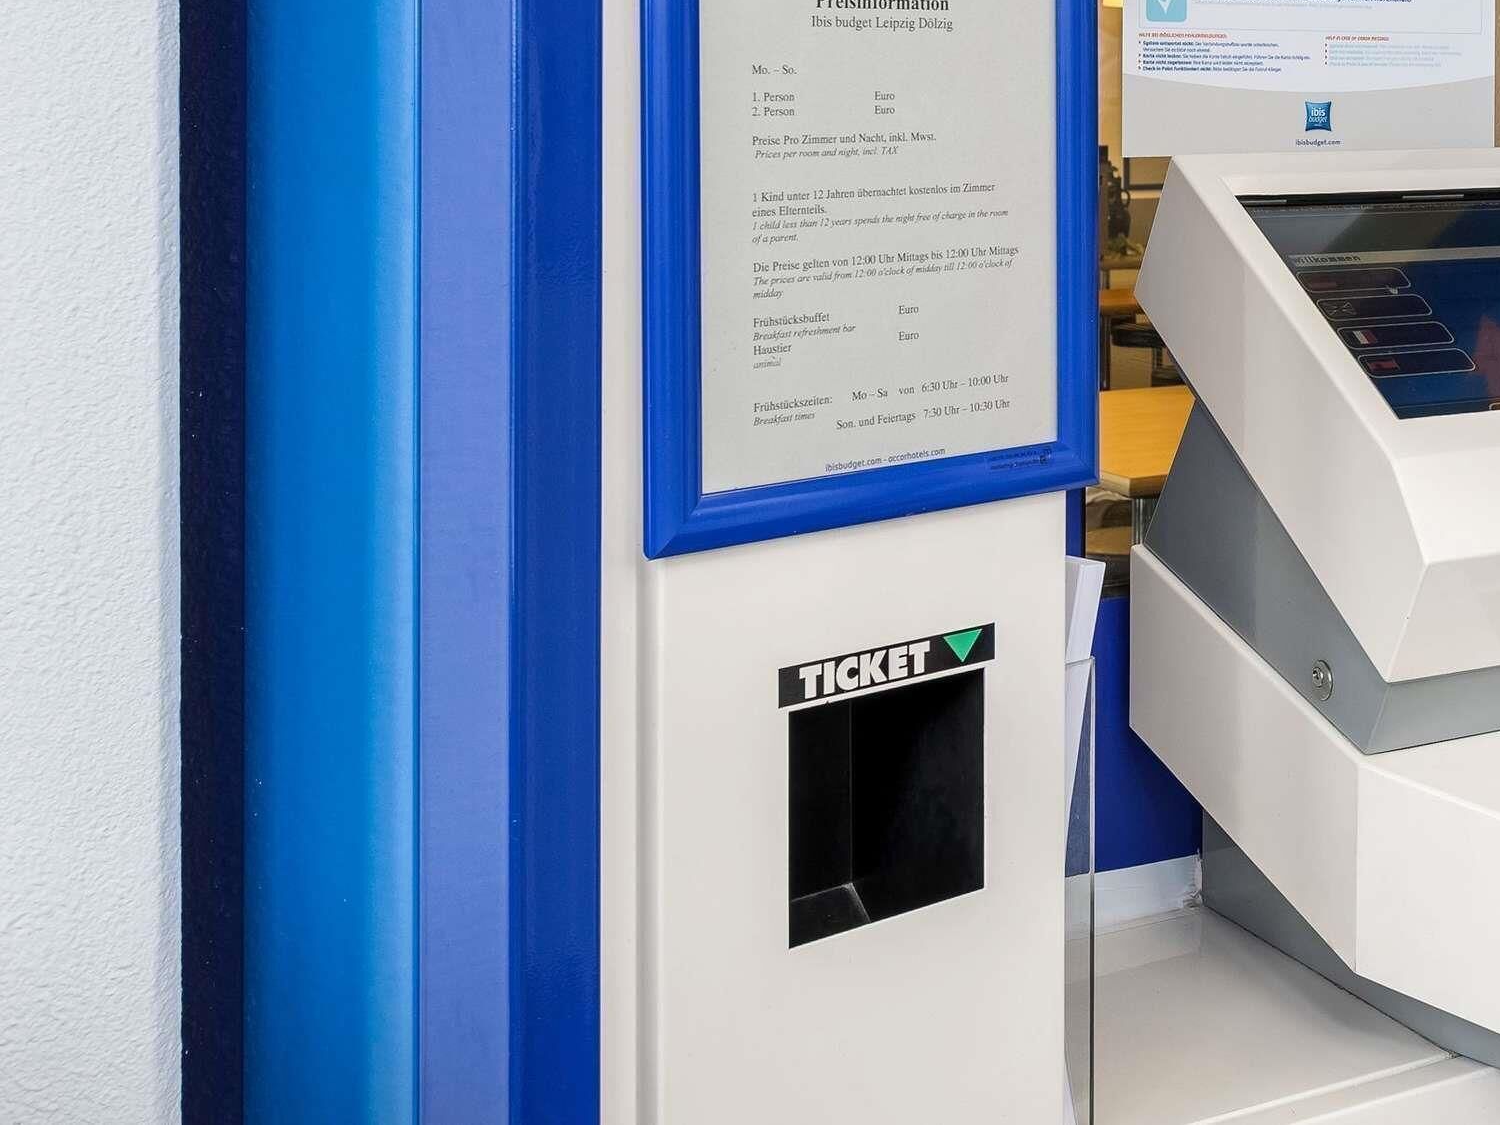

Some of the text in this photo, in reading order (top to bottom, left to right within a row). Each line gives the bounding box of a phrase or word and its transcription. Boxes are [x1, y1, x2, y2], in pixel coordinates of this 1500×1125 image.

[811, 15, 953, 32] Ibis budget Leipzig Dölzig
[751, 64, 797, 75] Mo. So.
[762, 92, 795, 102] Person
[874, 90, 895, 101] Euro
[752, 106, 797, 117] 2. Person
[874, 105, 895, 115] Euro
[751, 131, 936, 146] Preise Pro Zimmer und Nacht, inkl. Mwst.
[760, 191, 784, 202] Kind
[786, 192, 812, 201] unter
[813, 189, 824, 200] 12
[824, 188, 855, 199] Jahren
[856, 187, 906, 198] übernachtet
[908, 184, 948, 195] kostenlos
[962, 182, 996, 193] Zimmer
[751, 204, 827, 218] eines Elternteils.
[753, 245, 1019, 273] Die Preise gelten von 12:00 Uhr Mittags bis 12:00 Uhr Mittags
[898, 304, 919, 315] Euro
[753, 312, 830, 328] Frühstücksbuffet
[898, 330, 919, 341] Euro
[753, 342, 792, 355] Haustier
[898, 386, 915, 395] von
[920, 373, 1009, 393] 6:30 Uhr 10:00 Uhr
[851, 386, 888, 401] Mo Sa
[753, 395, 833, 412] Frühstückszeiten:
[923, 398, 1010, 419] 7:30 Uhr 10:30 Uhr
[836, 412, 917, 430] Son. und Feiertags
[799, 640, 930, 700] TICKET
